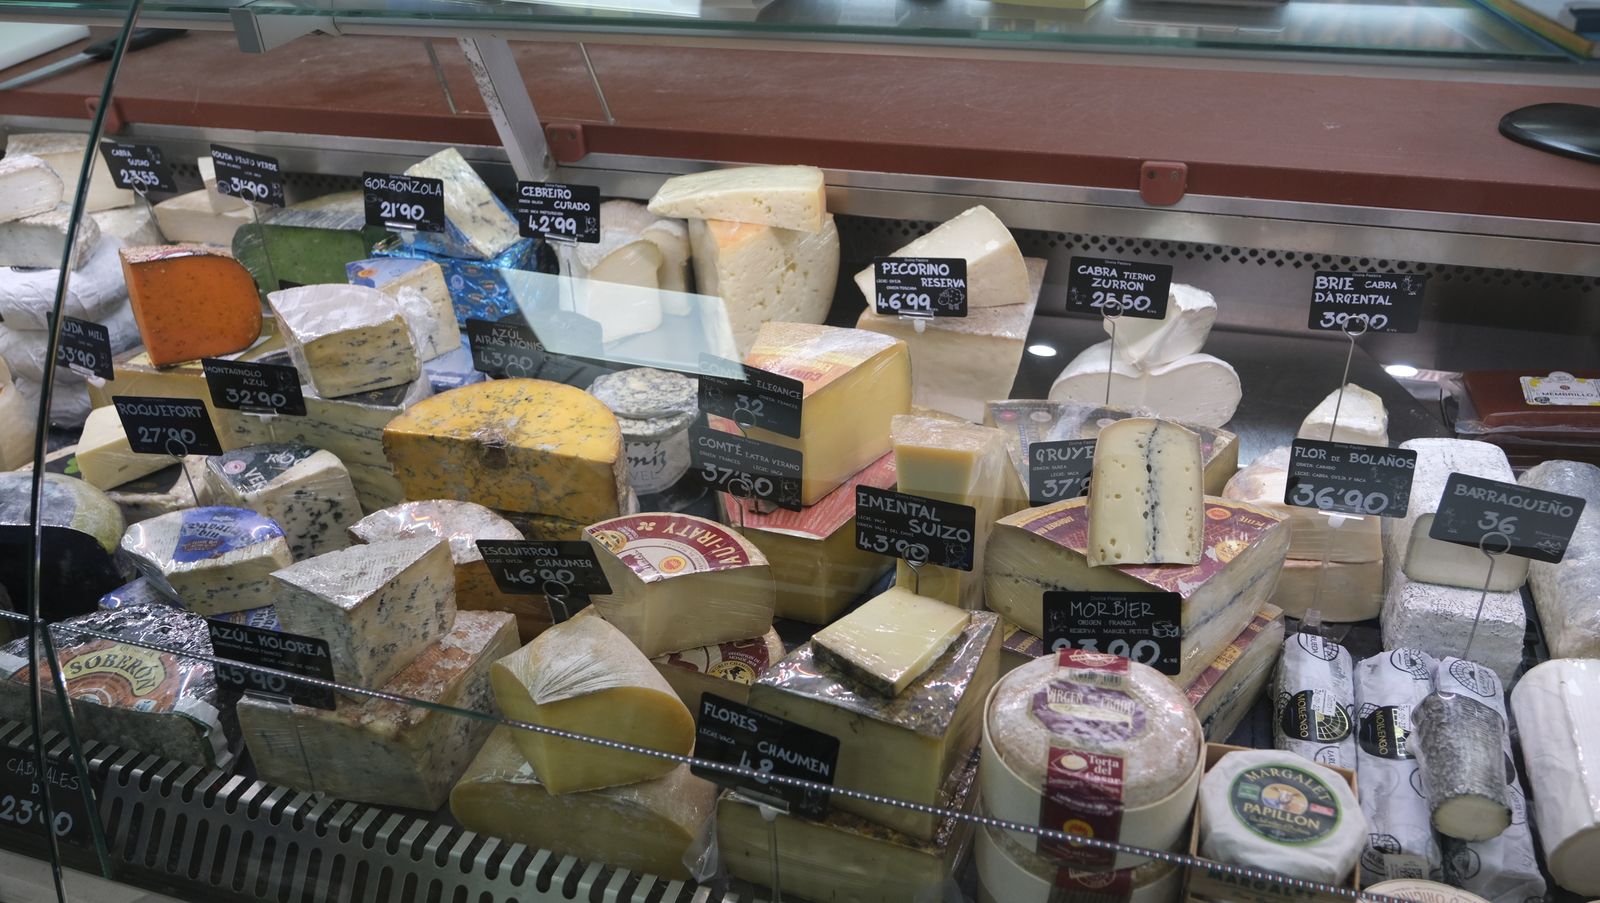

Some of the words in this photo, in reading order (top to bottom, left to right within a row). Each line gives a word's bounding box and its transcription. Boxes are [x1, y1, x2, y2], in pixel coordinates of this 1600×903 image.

[256, 161, 278, 172] VERDE
[365, 178, 442, 196] GORGONZOLA
[521, 186, 572, 199] CEBREIRO
[380, 201, 425, 220] 21'90
[553, 200, 590, 211] CURADO
[528, 215, 577, 235] 42'99
[881, 262, 950, 276] PECORINO
[1077, 265, 1118, 278] CABRA
[1123, 271, 1156, 282] TIERNO
[920, 277, 966, 288] RESERVA
[1091, 277, 1144, 292] ZURRON
[1315, 276, 1354, 291] BRIE
[1364, 280, 1398, 290] CABRA
[877, 292, 931, 311] 46'99
[204, 366, 262, 378] MONTAGNOLO
[242, 379, 268, 387] AZUL
[225, 388, 287, 408] 32'90
[734, 394, 764, 417] 32
[116, 402, 203, 418] ROQUEFORT
[771, 458, 800, 472] VERANO
[1294, 446, 1327, 461] FLOR
[1331, 455, 1341, 463] DE
[1348, 452, 1415, 470] BOLAÑOS
[857, 492, 941, 522] EMENTAL
[1293, 483, 1389, 515] 36'90
[1454, 483, 1573, 518] BARRAQUEÑO
[908, 519, 971, 543] SUIZO
[1477, 510, 1519, 535] 36
[481, 546, 559, 557] ESQUIRROU
[504, 568, 575, 584] 46'90
[1070, 601, 1155, 619] MORBIER
[257, 634, 327, 658] KOLOREA
[69, 653, 155, 692] SOBERÓN
[703, 701, 759, 733] FLORES
[757, 741, 830, 776] CHAUMEN
[1087, 754, 1120, 768] Torta
[1094, 764, 1113, 775] del
[1243, 768, 1332, 802] MARGALET
[1242, 802, 1321, 830] PAPILLON
